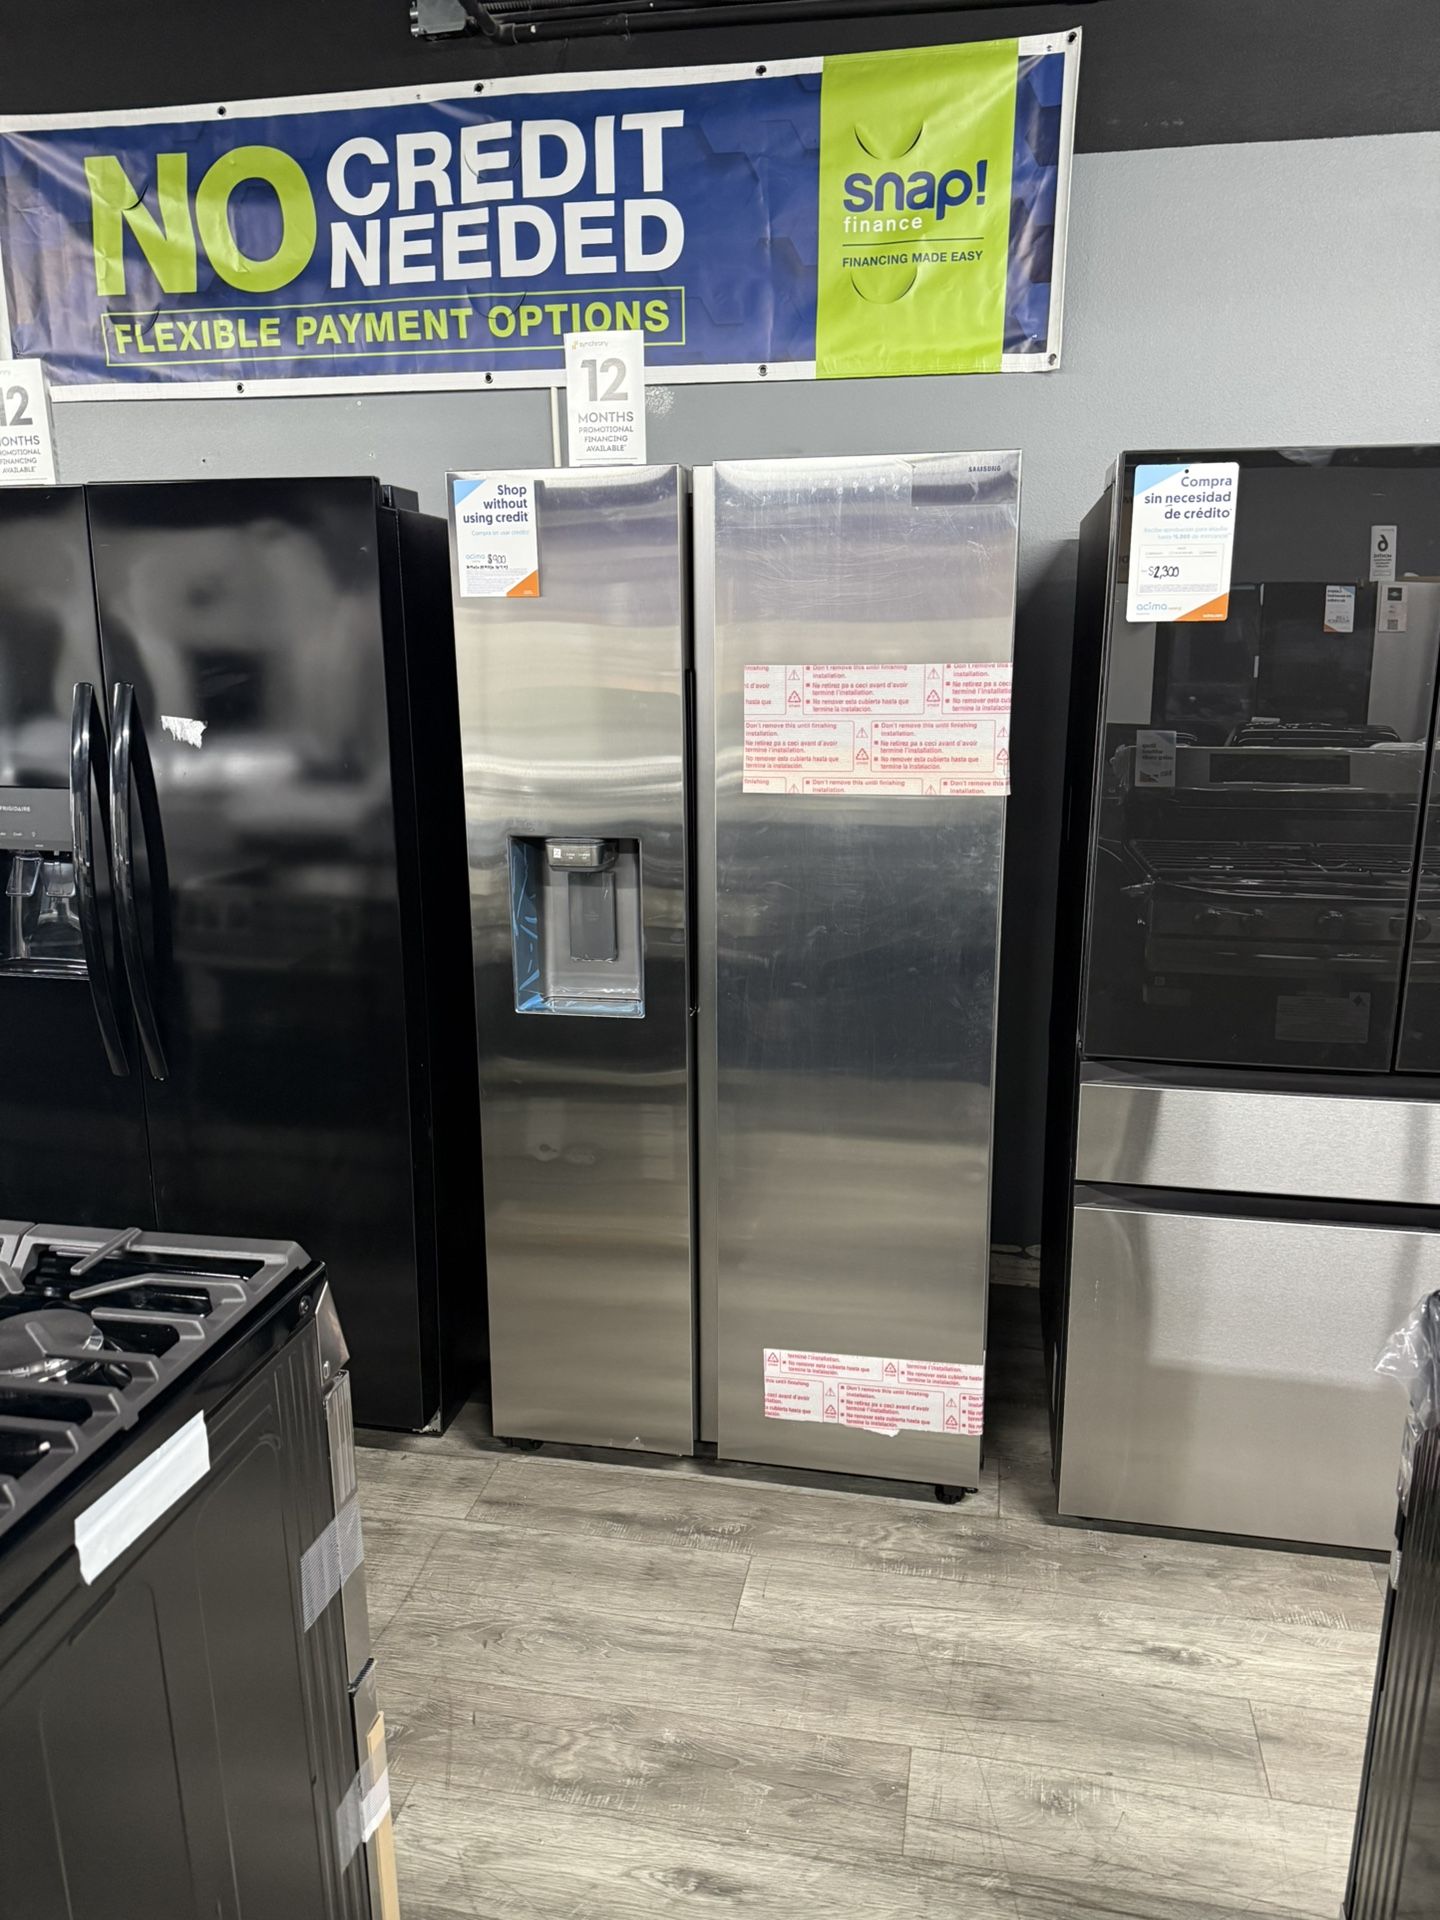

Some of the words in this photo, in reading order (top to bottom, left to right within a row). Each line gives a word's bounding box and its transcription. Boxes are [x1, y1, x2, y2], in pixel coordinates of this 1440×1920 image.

[327, 110, 684, 216] CREDIT
[843, 160, 988, 220] snap!
[84, 146, 317, 296] NO
[843, 216, 922, 233] finance
[330, 198, 685, 288] NEEDED
[842, 253, 908, 268] FINANCING
[911, 251, 947, 263] MADE
[951, 250, 983, 262] EASY
[115, 318, 281, 353] FLEXIBLE
[296, 308, 473, 346] PAYMENT
[488, 300, 669, 338] OPTIONS
[581, 358, 628, 402] 12
[578, 411, 634, 423] MONTHS
[579, 425, 634, 434] PROMOTIONAL
[0, 435, 40, 447] ONTHS
[584, 435, 628, 443] FINANCING
[1181, 476, 1232, 489] Compra
[497, 484, 527, 498] Shop
[1144, 492, 1162, 504] sin
[1165, 491, 1231, 504] necesidad
[483, 498, 528, 509] without
[463, 512, 493, 525] using
[495, 510, 528, 522] credit
[1164, 508, 1181, 519] de
[1148, 565, 1179, 580] $2,300
[1136, 602, 1167, 611] acima
